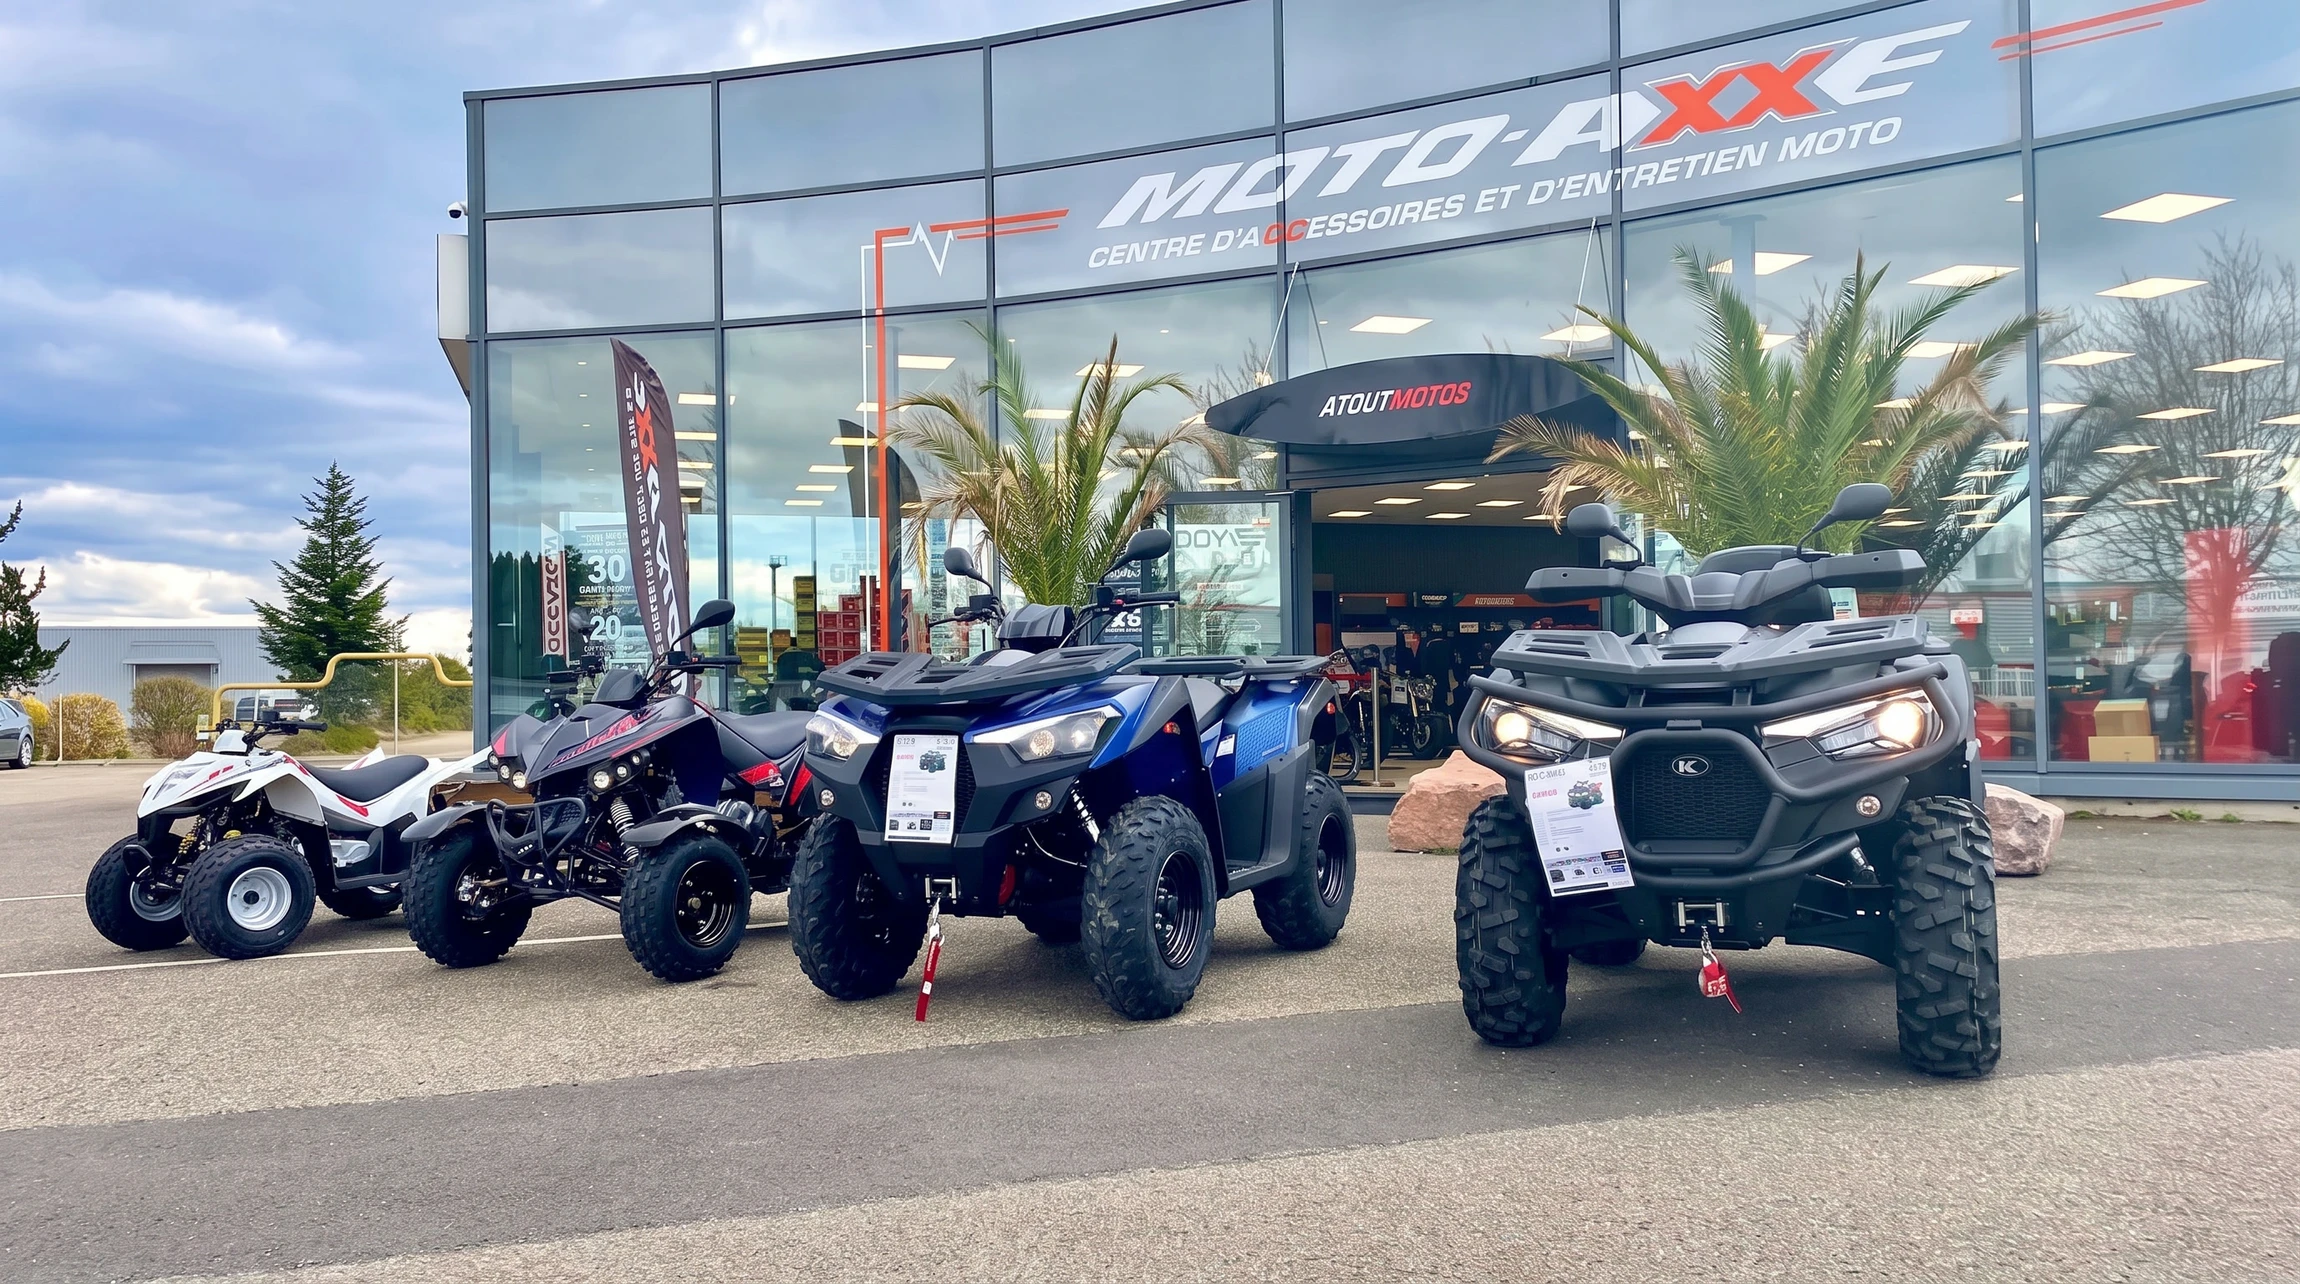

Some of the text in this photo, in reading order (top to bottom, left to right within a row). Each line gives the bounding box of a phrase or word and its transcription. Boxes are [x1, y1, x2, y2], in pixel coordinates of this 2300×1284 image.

[1096, 20, 1972, 230] MOTO-AXXE
[1088, 117, 1903, 269] CENTRE D'ACCESSOIRES ET D'ENTRETIEN MOTO
[587, 554, 626, 584] 30
[589, 614, 622, 641] 20
